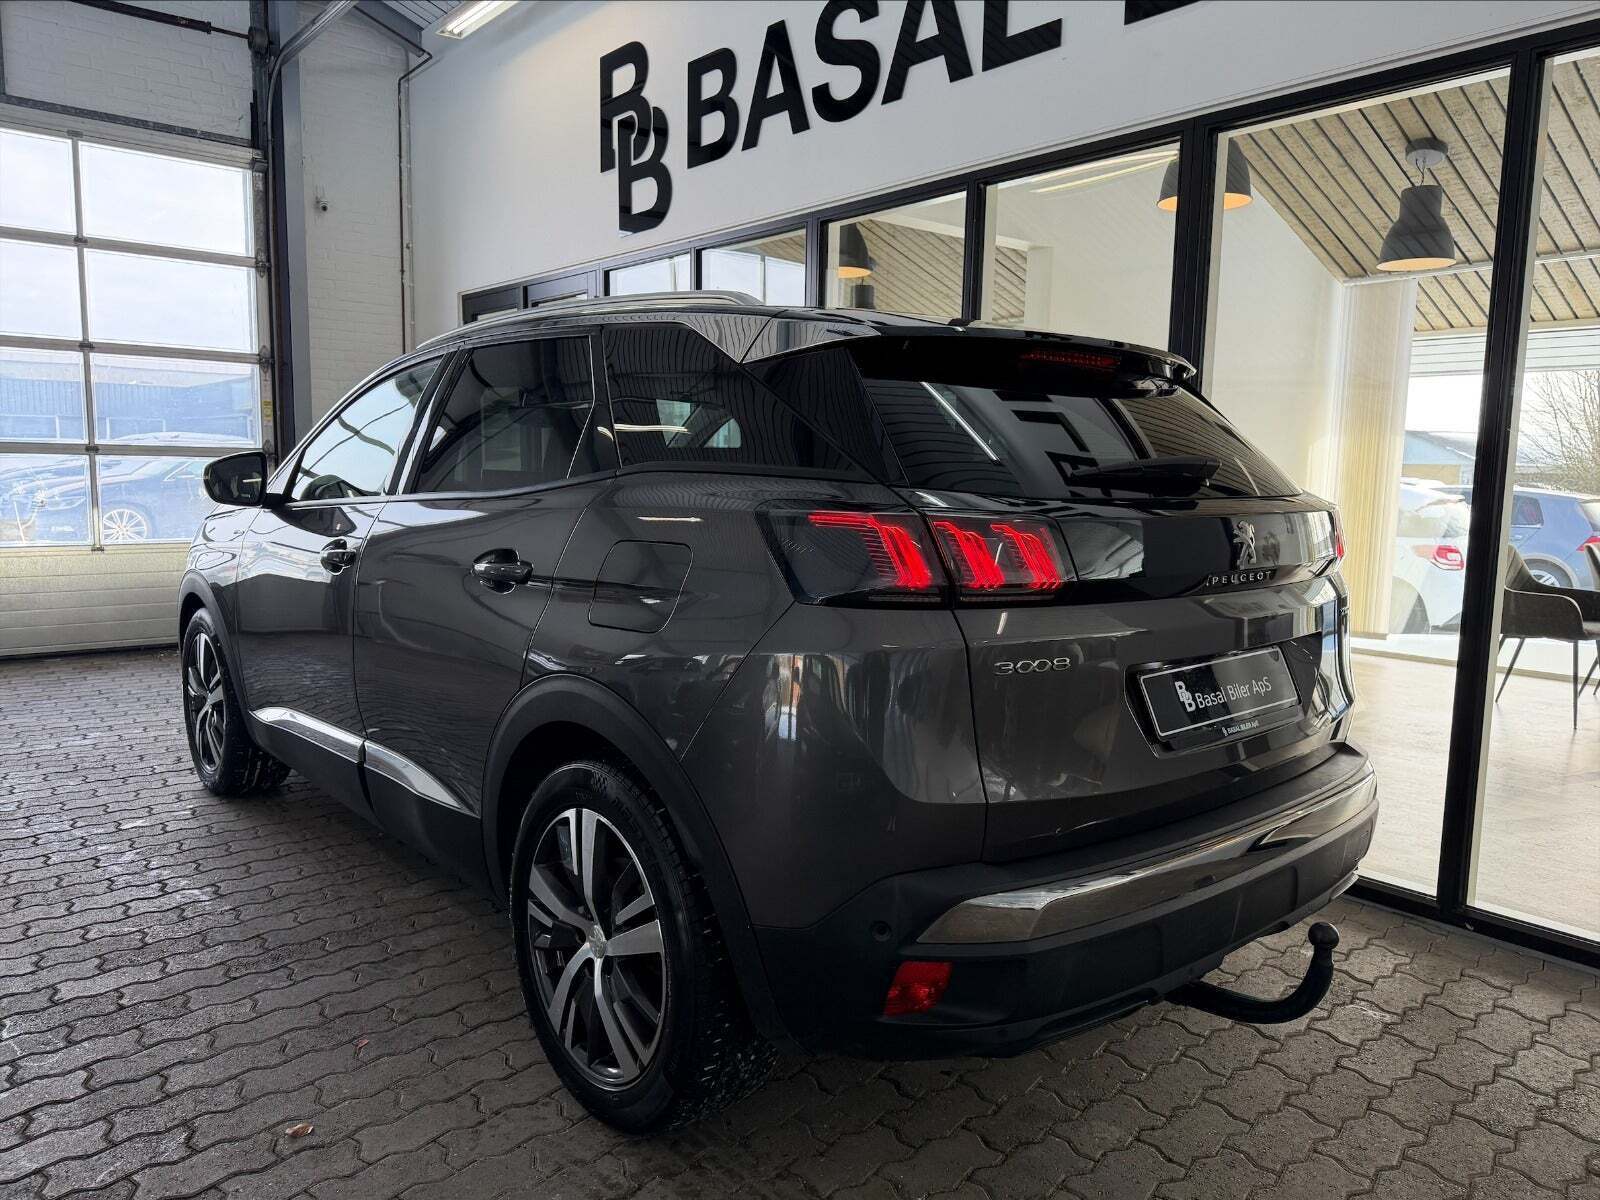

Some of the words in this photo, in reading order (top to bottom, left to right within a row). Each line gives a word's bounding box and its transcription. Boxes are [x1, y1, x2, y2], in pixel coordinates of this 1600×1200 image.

[1211, 570, 1272, 585] PEUGEOT
[993, 657, 1071, 675] 3008
[1195, 687, 1227, 709] Basal
[1227, 682, 1251, 701] Biler
[1252, 676, 1272, 697] ApS
